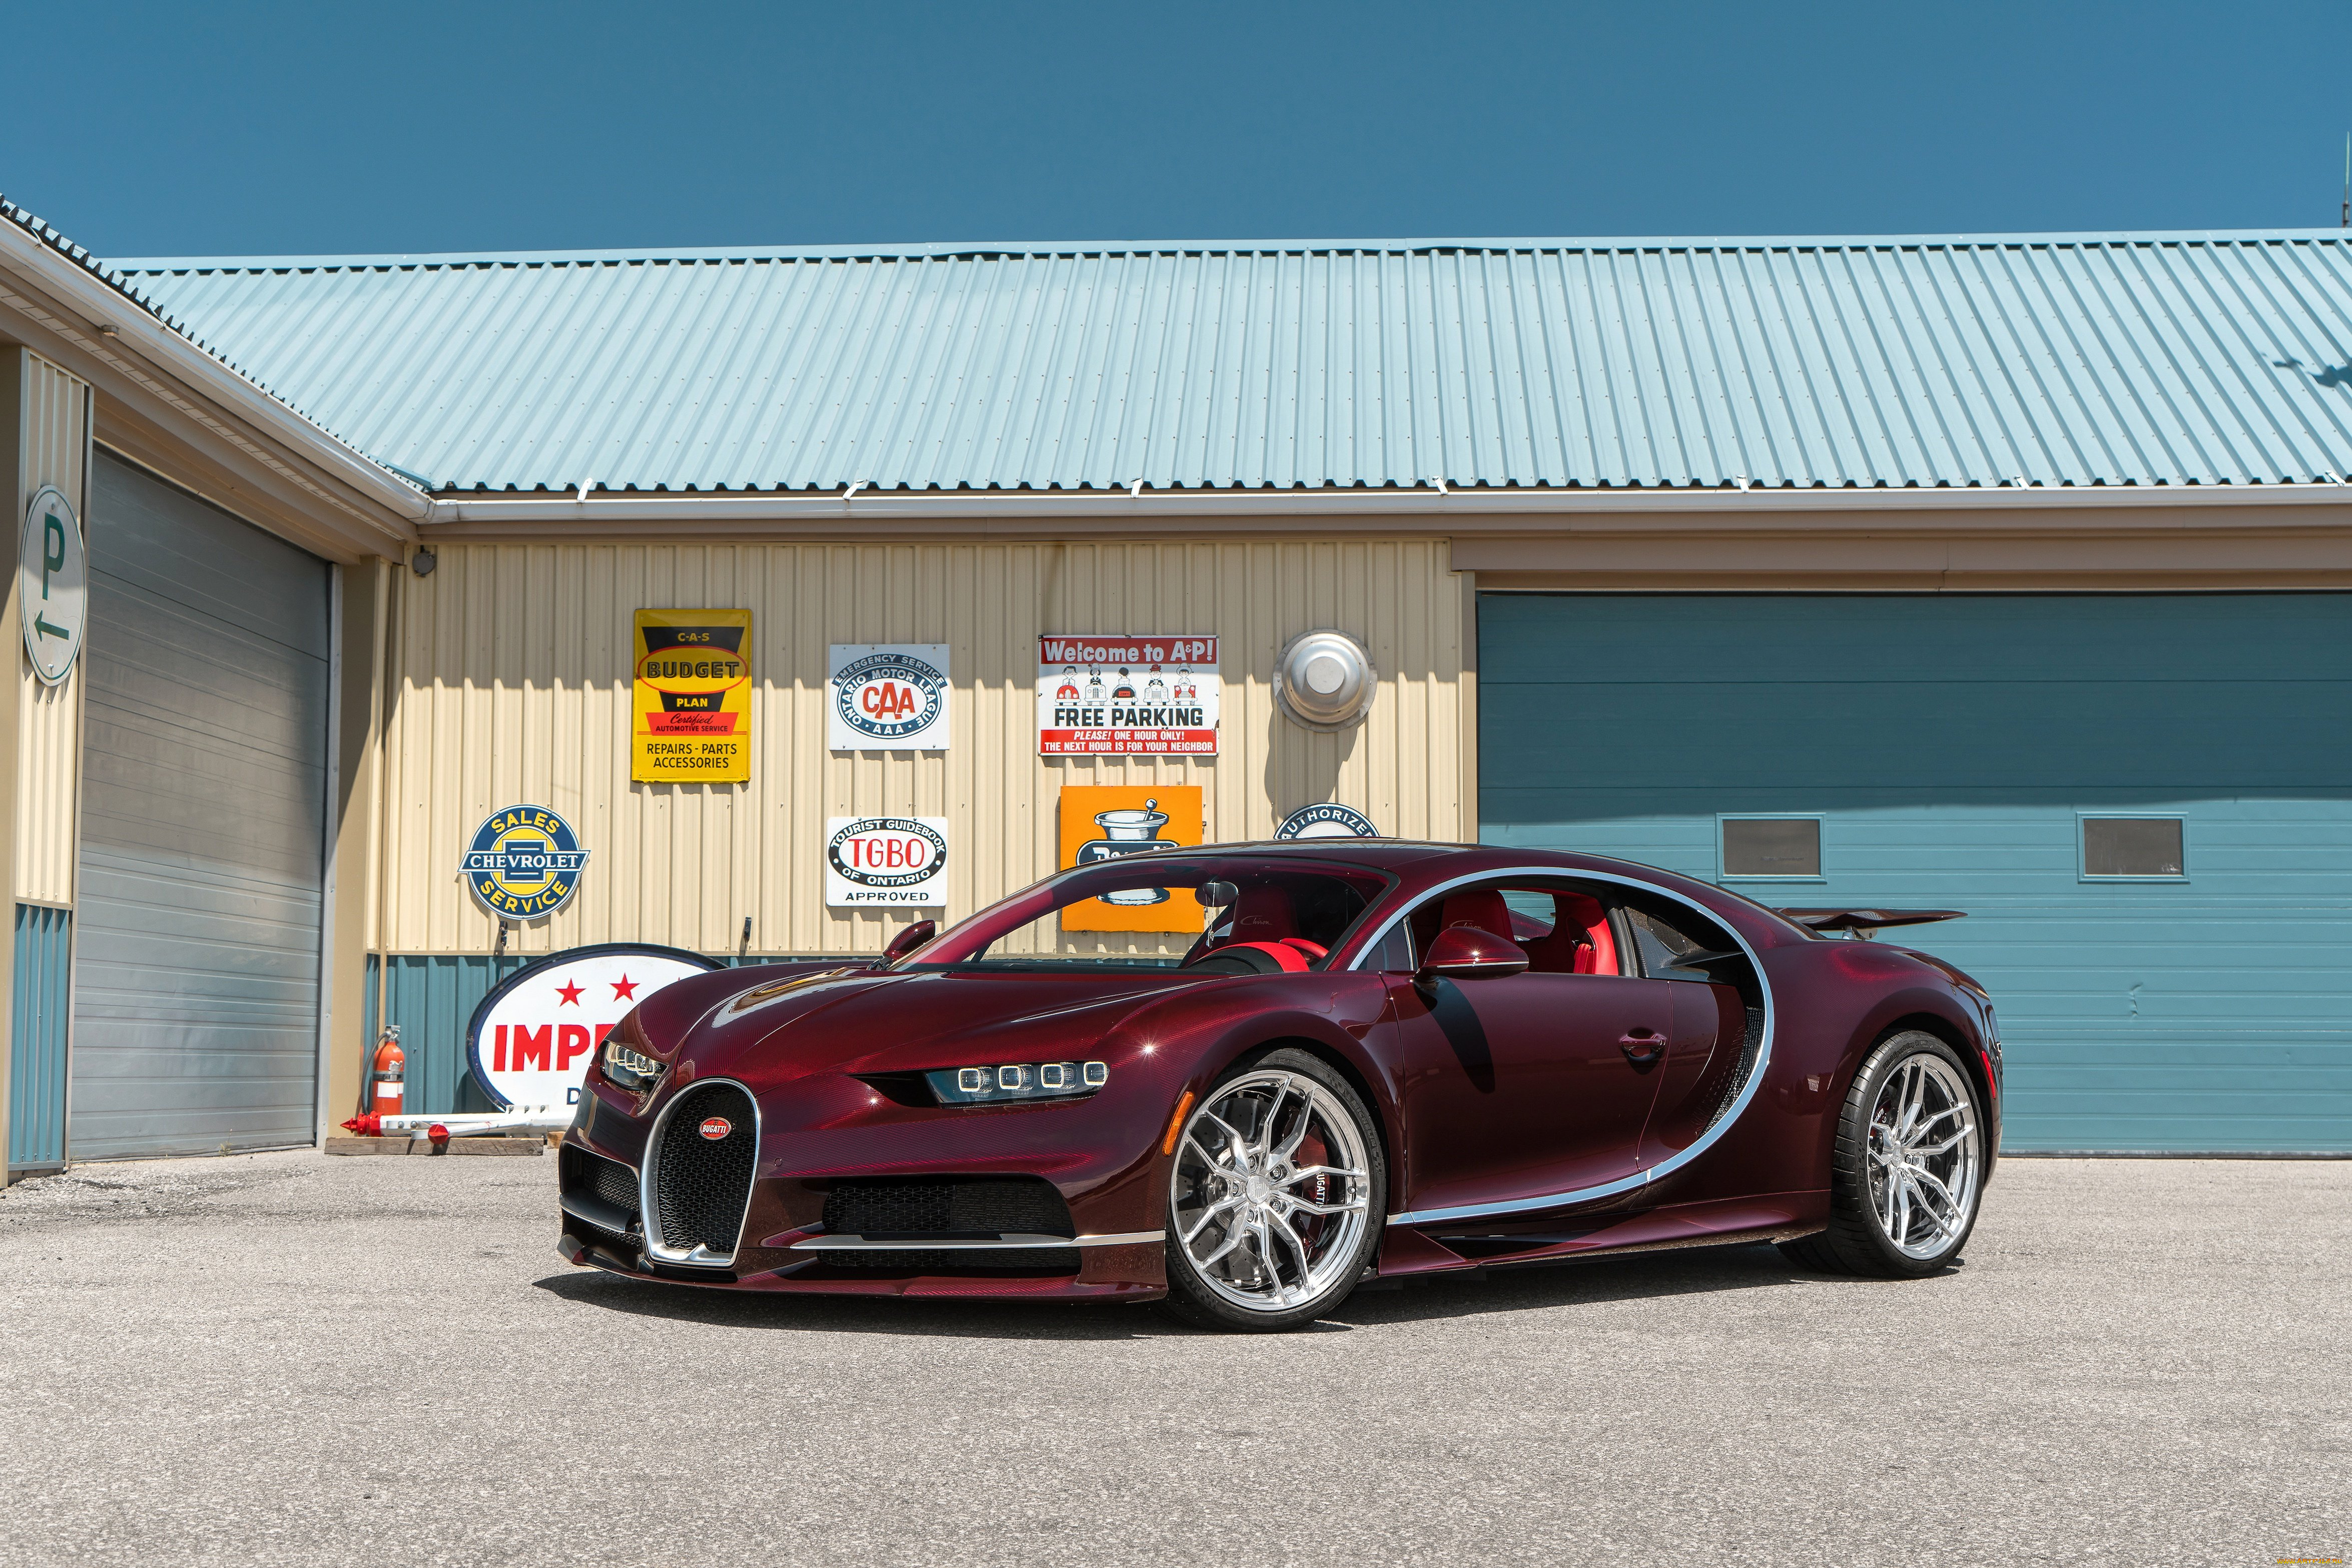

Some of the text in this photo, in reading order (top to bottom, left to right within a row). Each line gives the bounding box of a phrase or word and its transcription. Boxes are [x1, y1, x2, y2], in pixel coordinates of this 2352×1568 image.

[42, 512, 65, 600] P
[1044, 639, 1213, 662] Welcome to A&P!
[647, 661, 739, 678] BUDGET
[835, 654, 945, 685] EMERGENCY SERVICE
[677, 698, 708, 707] PLAN
[842, 668, 936, 727] ONTARIO MOTOR LEAGUE
[863, 682, 915, 719] CAA
[670, 713, 714, 724] Certified
[1054, 707, 1203, 726] FREE PARKING
[872, 724, 904, 734] AAA
[1073, 730, 1185, 740] PLEASE! ONE HOUR ONLY!
[647, 743, 692, 754] REPAIRS
[702, 743, 737, 754] PARTS
[1044, 741, 1213, 751] THE NEXT HOUR IS FOR YOUR NEIGHBOR
[653, 757, 729, 768] ACCESSORIES
[491, 810, 560, 834] SALES
[830, 820, 945, 854] TOURIST GUIDEBOOK
[470, 855, 578, 868] CHEVROLET
[848, 839, 925, 868] TGBO
[842, 868, 930, 886] OF ONTARIO
[480, 880, 568, 913] SERVICE
[845, 892, 929, 901] APPROVED
[1240, 915, 1273, 925] Chiron
[702, 1125, 727, 1134] BUGATTI
